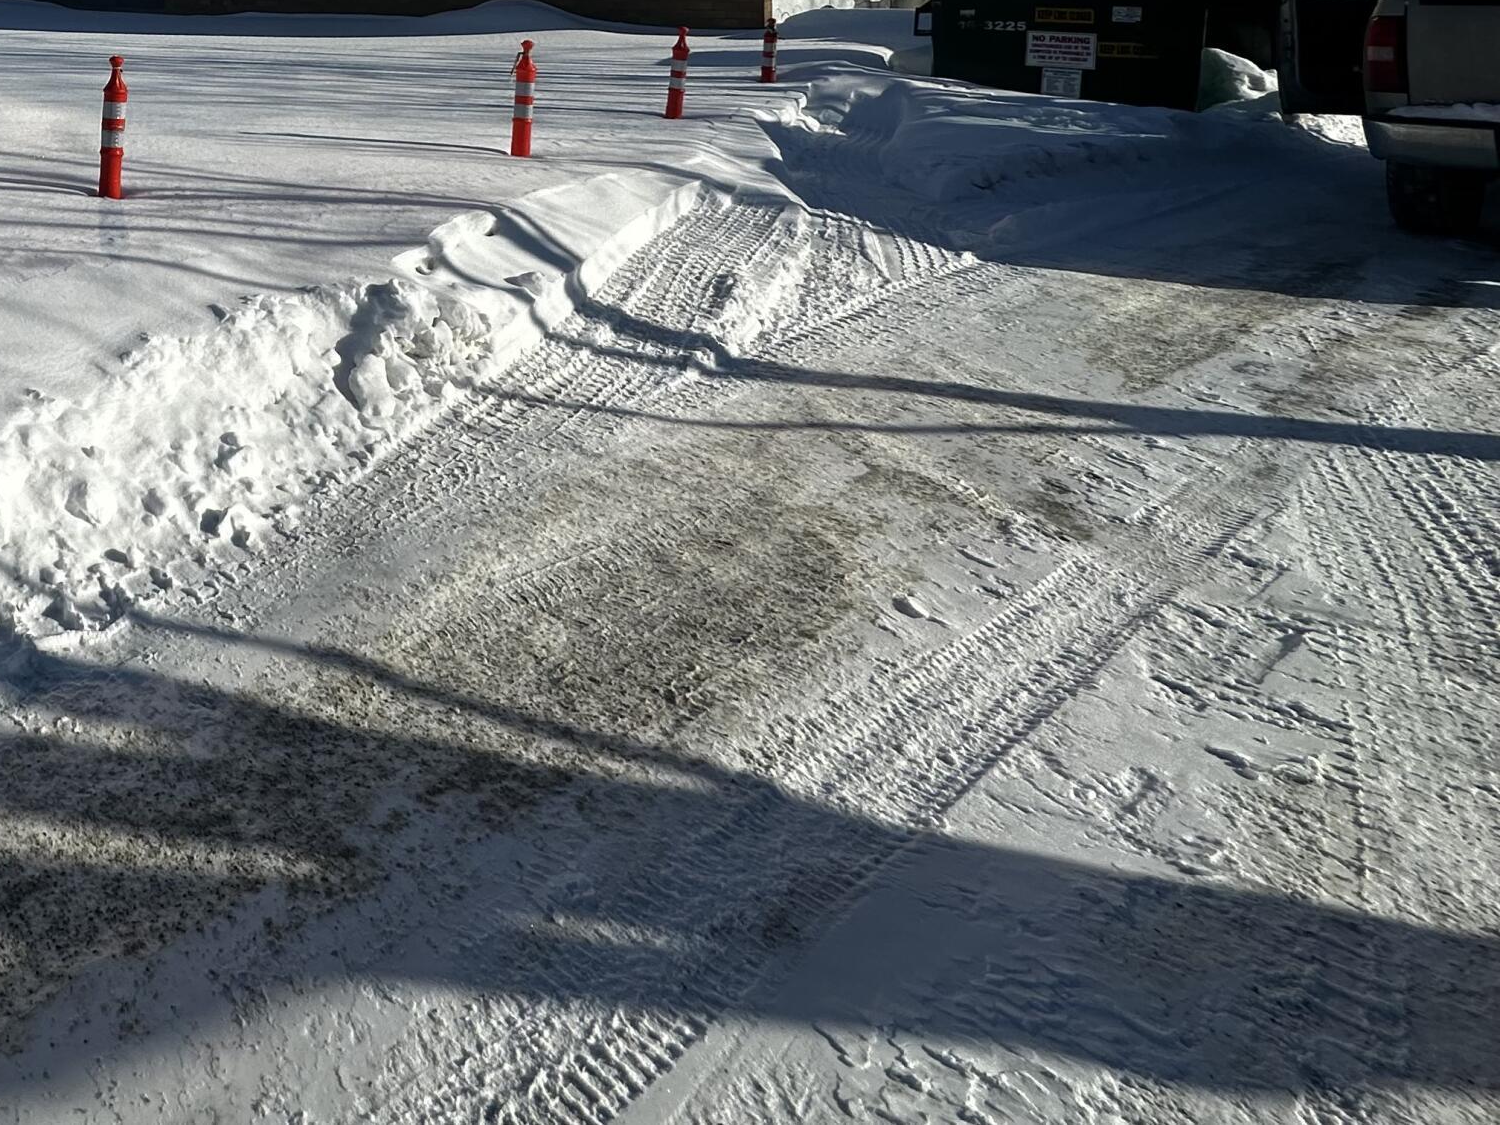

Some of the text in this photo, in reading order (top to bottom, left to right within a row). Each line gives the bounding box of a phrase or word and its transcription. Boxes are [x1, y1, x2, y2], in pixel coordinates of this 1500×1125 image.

[983, 20, 1027, 31] 3225
[1032, 35, 1090, 44] NO PARKING
